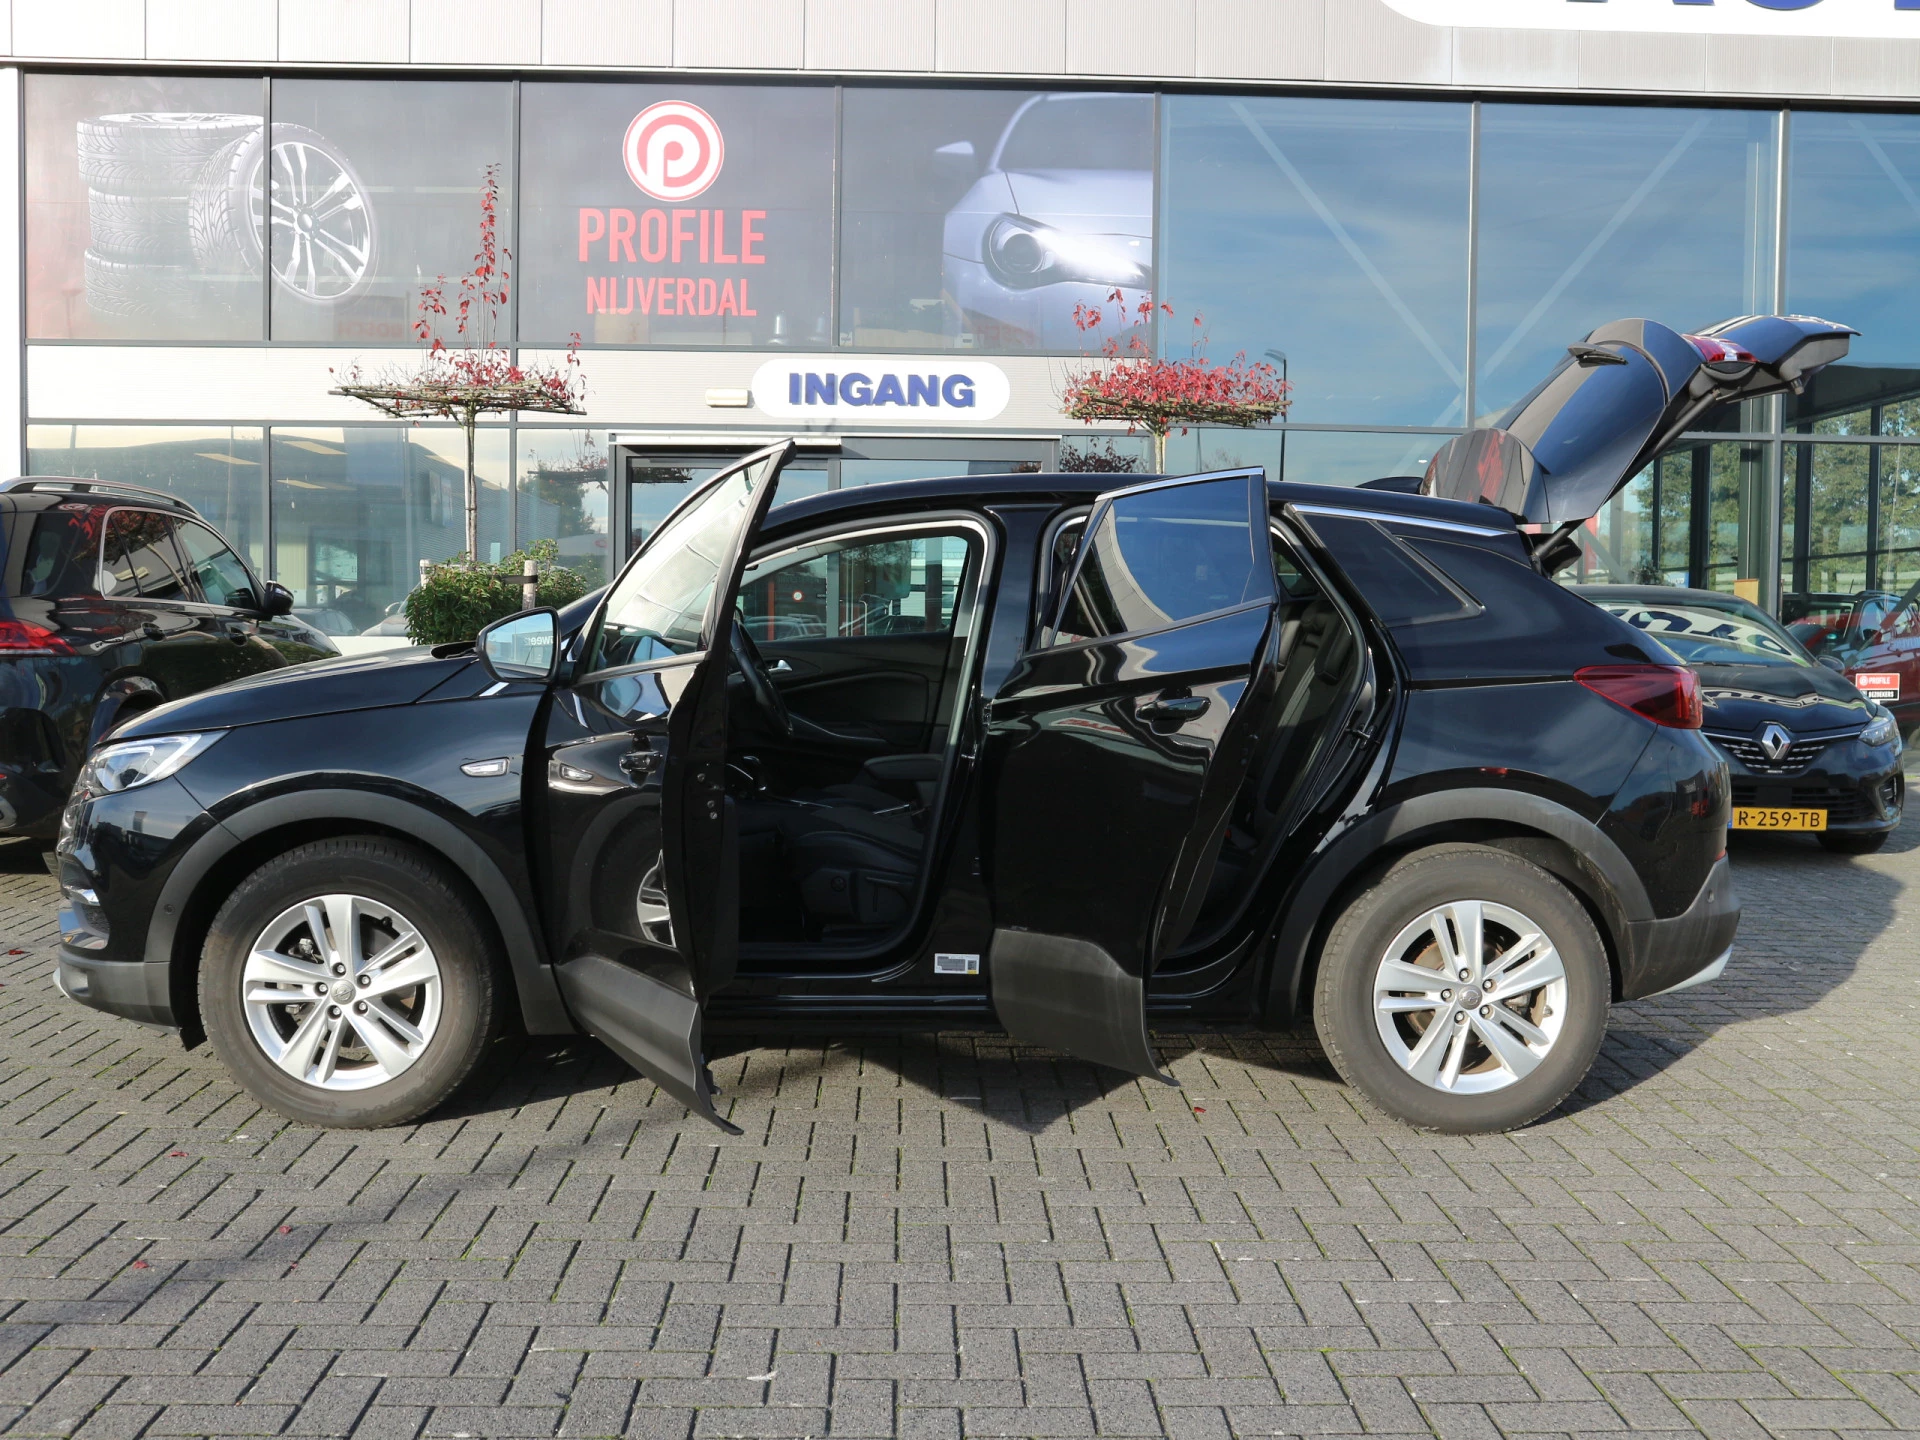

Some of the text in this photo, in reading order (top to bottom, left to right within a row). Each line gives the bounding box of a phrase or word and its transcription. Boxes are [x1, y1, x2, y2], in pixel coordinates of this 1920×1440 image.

[577, 207, 767, 265] PROFILE
[586, 276, 757, 317] NIJVERDAL
[788, 371, 976, 409] INGANG
[1868, 676, 1891, 685] PROFILE
[1738, 810, 1820, 827] R-259-TB
